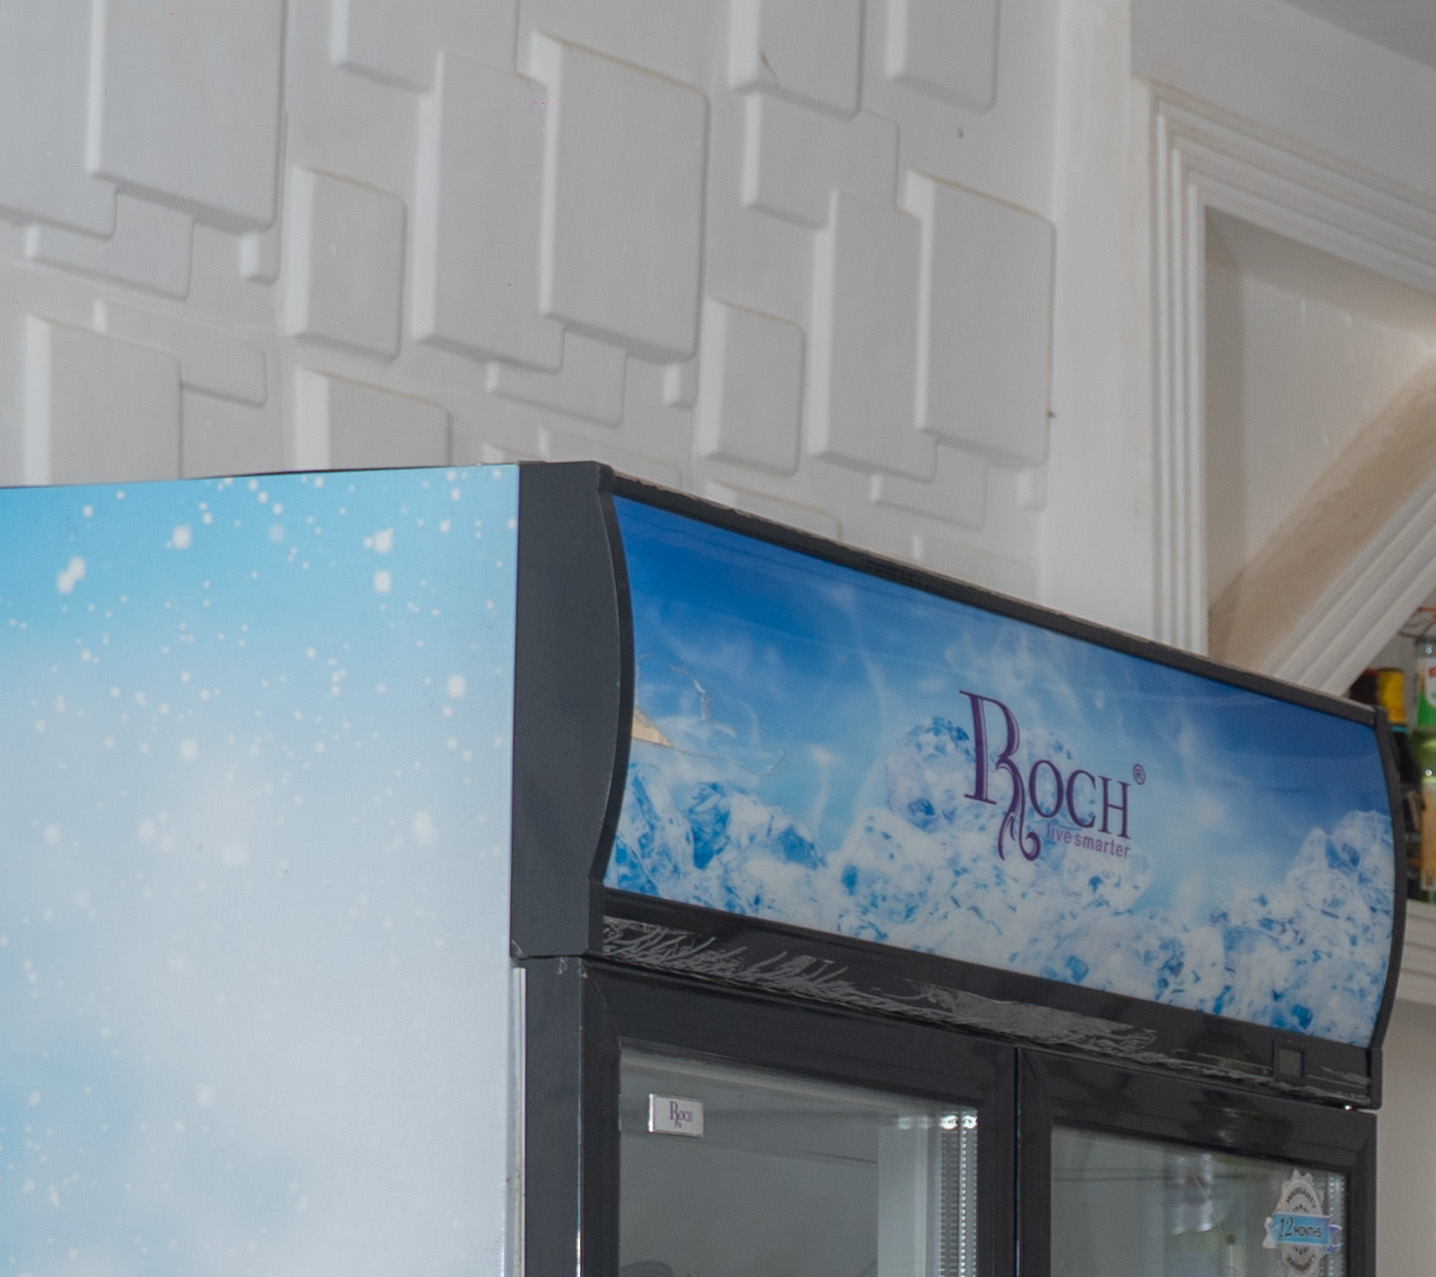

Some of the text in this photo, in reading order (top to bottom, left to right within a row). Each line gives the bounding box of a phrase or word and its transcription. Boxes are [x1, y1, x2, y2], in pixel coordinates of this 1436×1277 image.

[959, 689, 1131, 862] ROCH
[1074, 834, 1131, 860] smarter
[1279, 1216, 1294, 1239] 12
